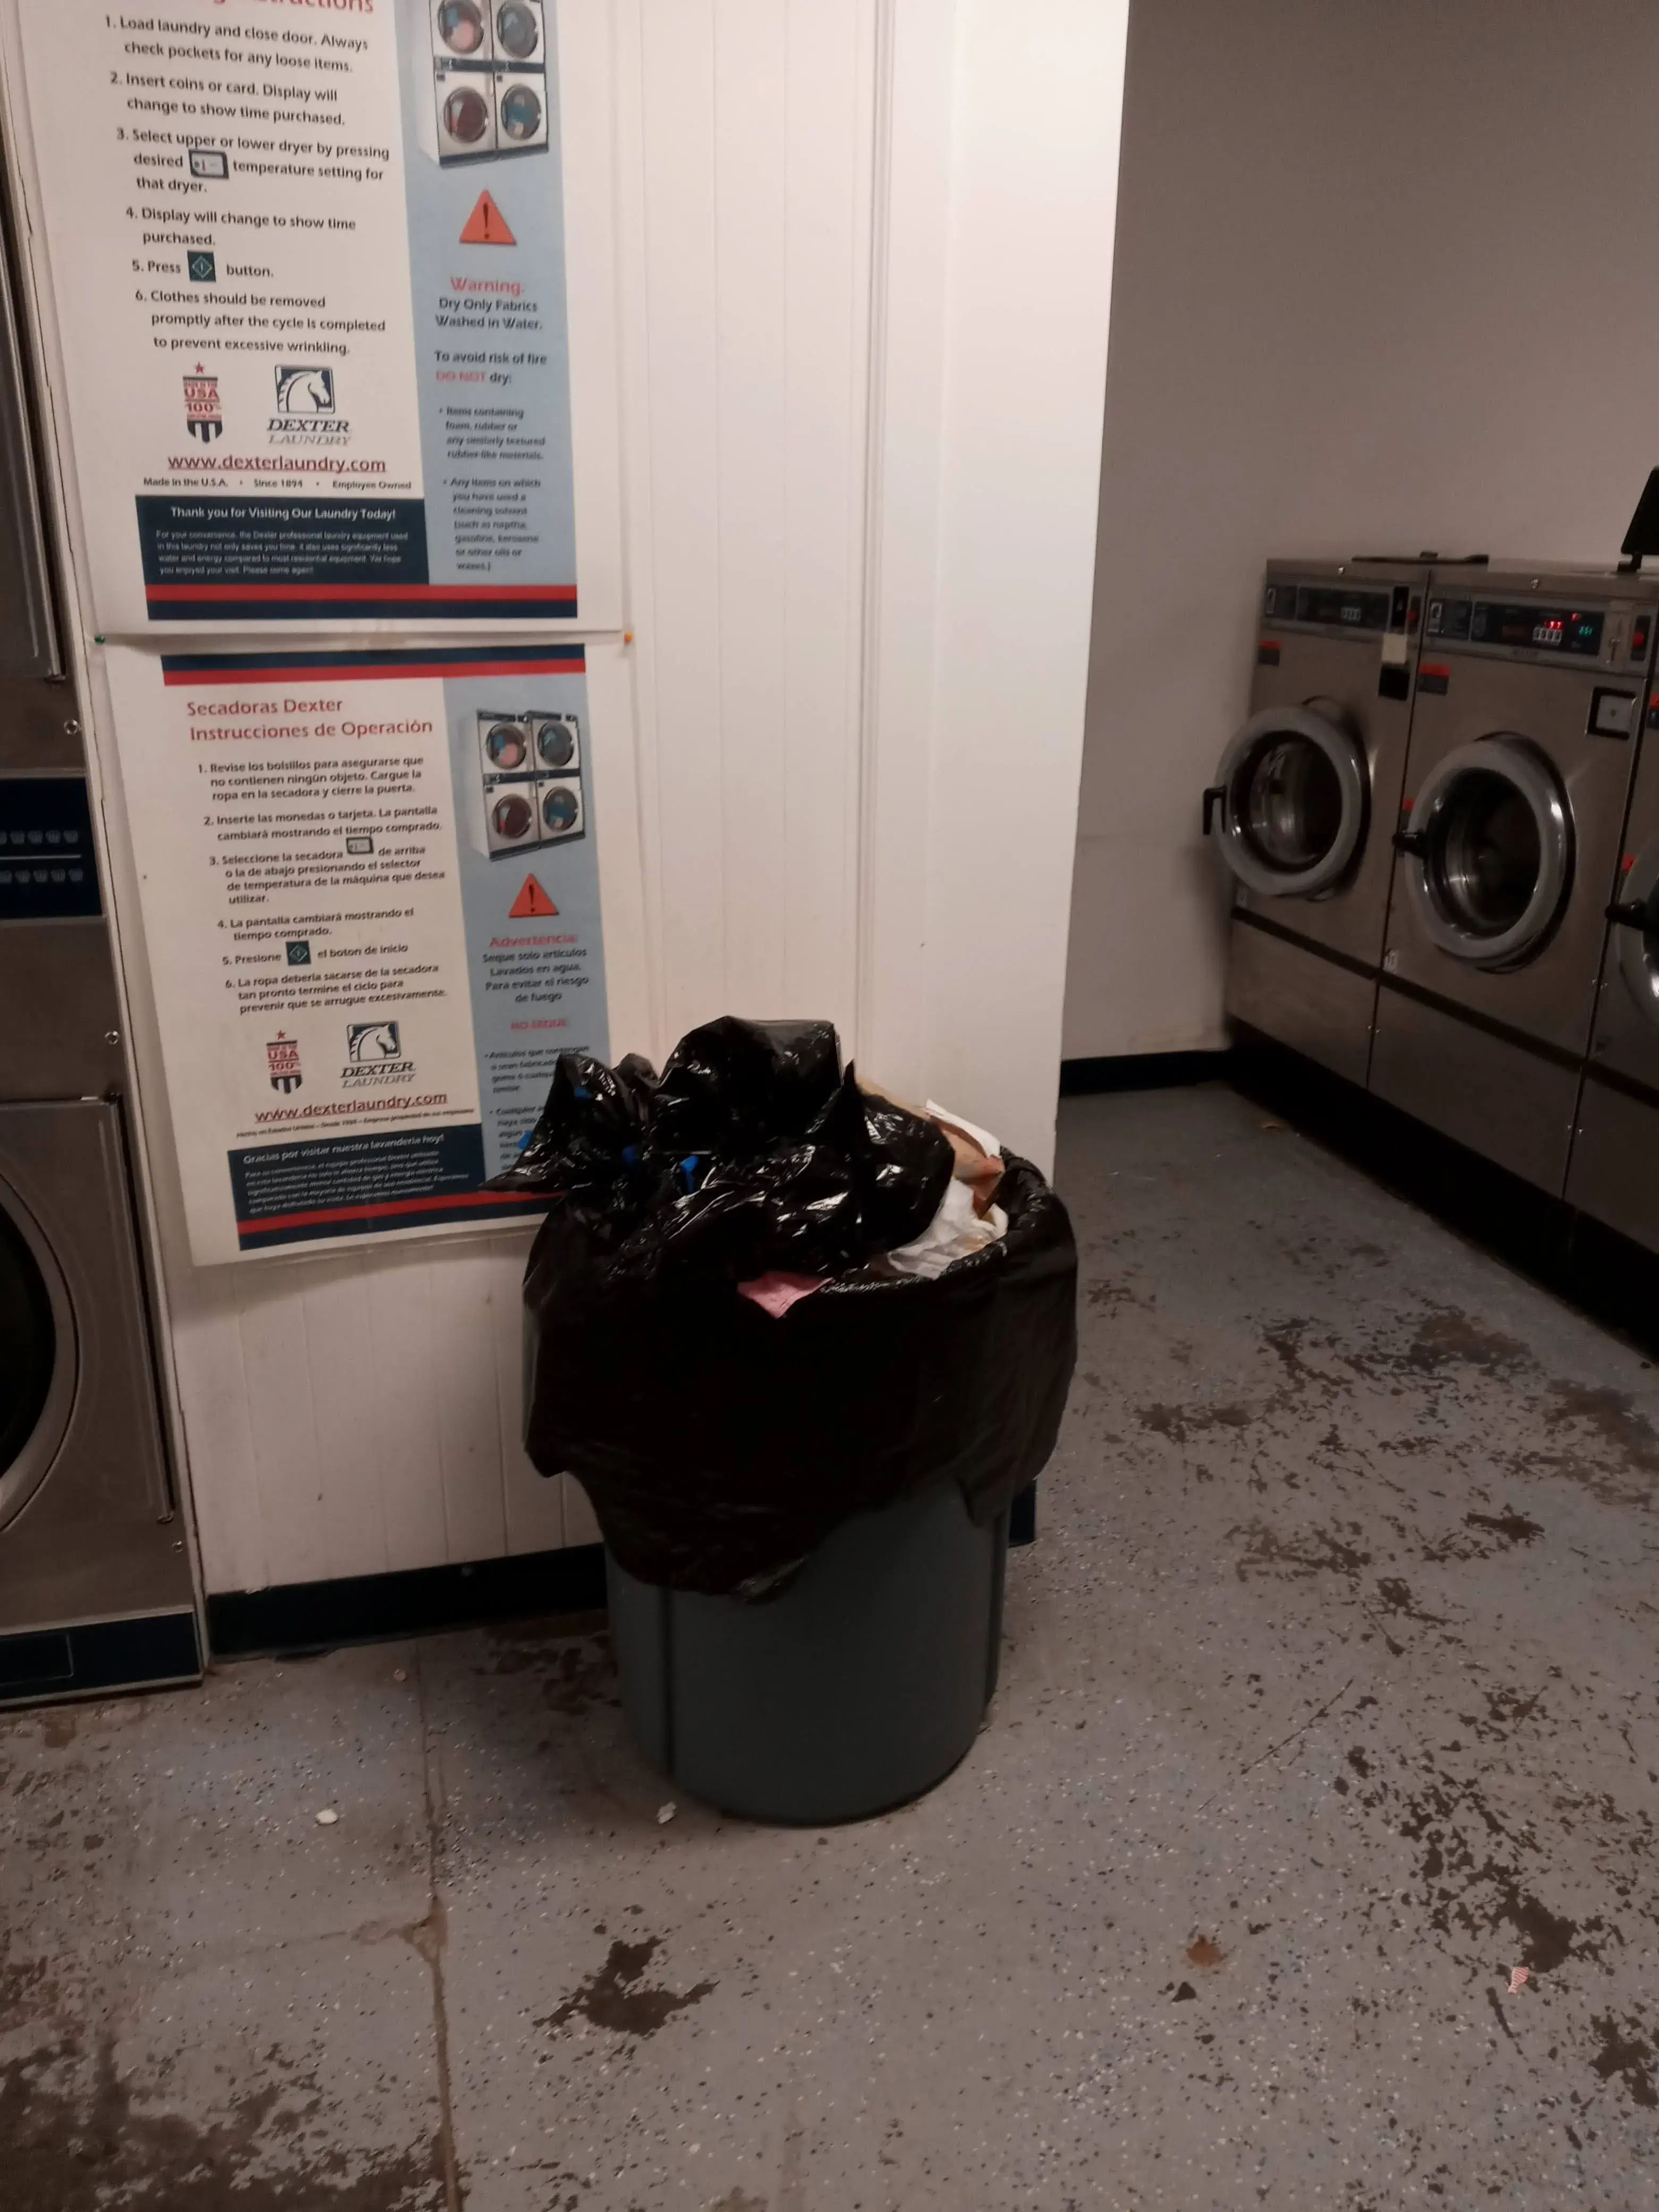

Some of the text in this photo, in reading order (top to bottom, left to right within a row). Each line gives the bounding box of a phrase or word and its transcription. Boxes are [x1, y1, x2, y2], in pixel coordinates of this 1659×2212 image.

[105, 14, 368, 52] 1. Load laundry and close door. Always
[124, 41, 164, 55] check
[168, 46, 221, 60] pockets
[224, 48, 242, 62] for
[247, 54, 272, 67] any
[275, 53, 311, 67] loose
[111, 71, 337, 102] 2. Insert coins or card. Display will
[127, 97, 345, 124] change to show time purchased.
[116, 127, 390, 161] 3. Select upper or lower dryer by pressing
[133, 153, 383, 181] desired temperature setting for
[136, 177, 206, 194] that dryer.
[125, 206, 356, 229] 4. Display will change to show time
[143, 232, 215, 246] purchased.
[131, 259, 273, 276] 5. Press button.
[135, 289, 325, 307] 6. Clothes should be removed
[439, 297, 537, 313] Dry Only Fabrics
[151, 314, 385, 332] promptly after the cycle is completed
[435, 315, 542, 329] Washed in Water.
[153, 337, 167, 347] to
[171, 339, 221, 350] prevent
[224, 340, 283, 350] excessive
[434, 350, 449, 362] To
[453, 352, 485, 363] avoid
[489, 353, 509, 363] risk
[512, 353, 524, 364] of
[184, 387, 220, 399] USA
[267, 419, 349, 432] DEXTER
[268, 434, 350, 445] LAUNDRY
[168, 456, 387, 474] www.dexterlaundry.com
[254, 479, 277, 487] Since
[170, 506, 204, 517] Thank
[207, 509, 228, 520] you
[230, 507, 246, 517] for
[248, 507, 289, 521] Visiting
[291, 508, 312, 518] Our
[314, 508, 358, 521] Laundry
[187, 699, 343, 717] Secadoras Dexter
[189, 719, 433, 741] Instrucciones de Operación
[198, 757, 423, 773] 1. Revise los bolsillos para asegurarse que
[228, 776, 284, 785] contienen
[287, 774, 327, 785] ningún
[329, 773, 367, 784] objeto.
[370, 771, 409, 782] Cargue
[412, 769, 421, 778] la
[212, 792, 238, 802] ropa
[257, 789, 267, 798] la
[271, 786, 320, 798] secadora
[322, 788, 329, 799] y
[331, 786, 362, 795] cierre
[364, 785, 374, 794] la
[204, 816, 214, 825] 2.
[216, 815, 255, 824] Inserte
[257, 814, 273, 823] las
[275, 812, 325, 822] monedas
[338, 810, 376, 821] tarjeta.
[378, 808, 391, 817] La
[393, 806, 438, 818] pantalla
[217, 830, 268, 840] cambiará
[271, 827, 330, 837] mostrando
[332, 826, 342, 835] el
[345, 825, 383, 836] tiempo
[217, 907, 414, 929] 4. La pantalla cambiará mostrando el
[233, 929, 272, 941] tiempo
[267, 1050, 298, 1060] USA
[340, 1062, 416, 1078] DEXTER
[342, 1074, 416, 1088] LAUNDRY
[254, 1092, 448, 1124] www.dexterlaundry.com
